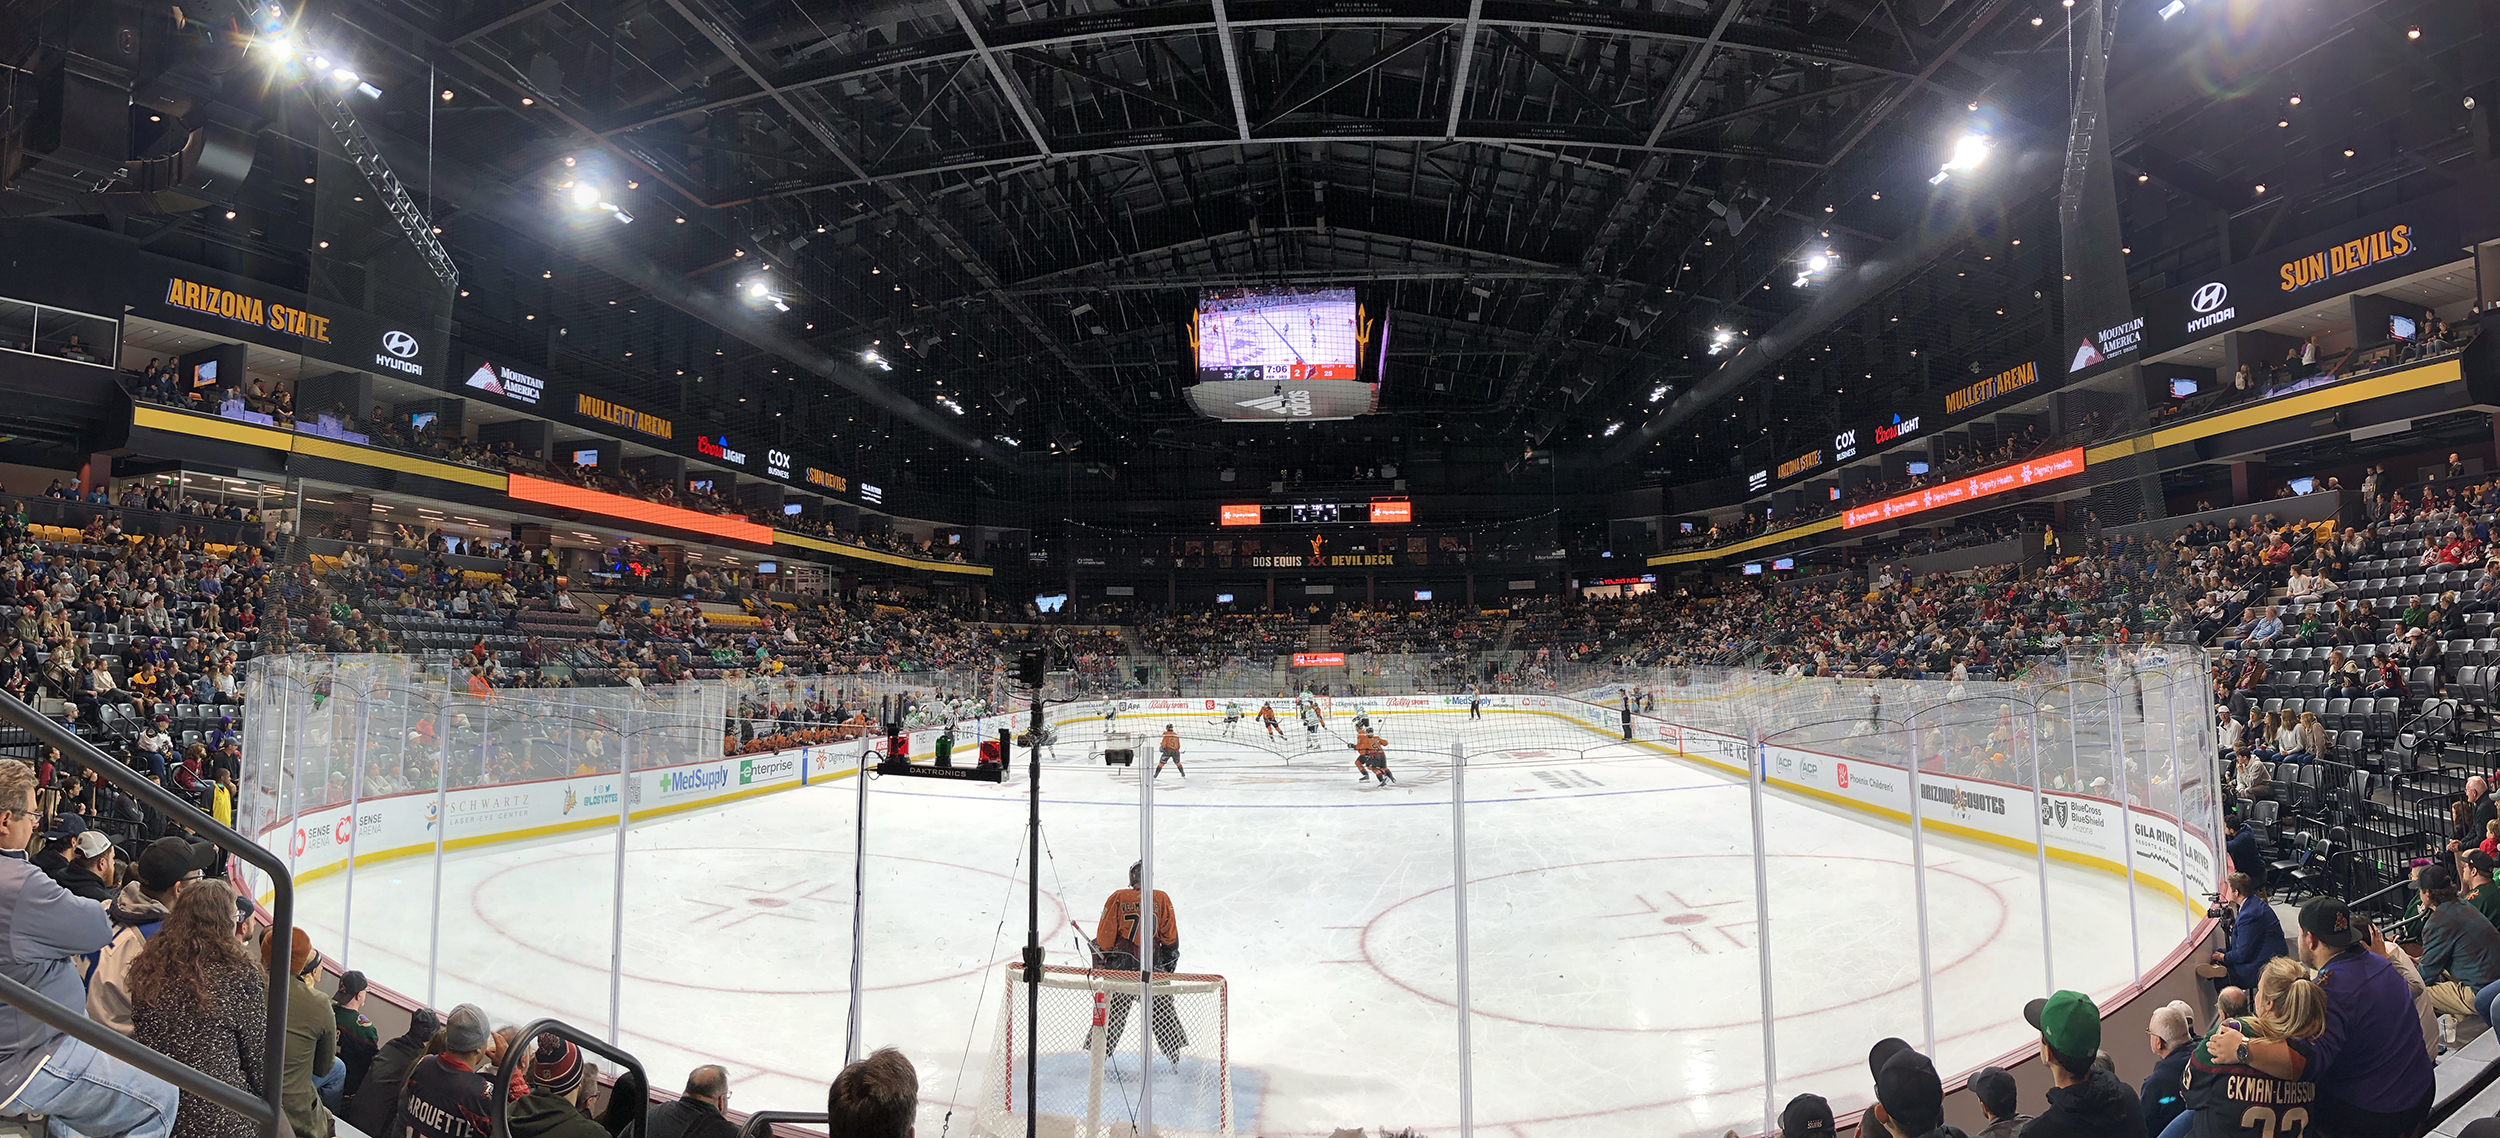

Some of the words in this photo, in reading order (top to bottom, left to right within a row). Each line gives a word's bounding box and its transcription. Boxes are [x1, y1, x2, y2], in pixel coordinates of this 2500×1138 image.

[2280, 251, 2329, 292] SUN
[2329, 224, 2412, 277] DEVILS
[165, 277, 264, 327] ARIZONA
[267, 303, 331, 344] STATE
[2187, 306, 2235, 333] HYUNDAI
[2098, 316, 2144, 344] MOUNTAIN
[2102, 331, 2141, 354] AMERICA
[376, 353, 423, 376] HYUNDAI
[1266, 365, 1287, 374] 7:06
[501, 366, 544, 390] MOUNTAIN
[1253, 370, 1260, 378] 6
[1294, 369, 1301, 377] 2
[503, 379, 541, 400] AMERICA
[1945, 376, 1997, 415] MULLETT
[1996, 360, 2039, 396] ARENA
[575, 393, 635, 429] MULLETT
[633, 411, 673, 440] ARENA
[1875, 425, 1898, 444] Coors
[1897, 416, 1920, 437] LIGHT
[1835, 429, 1856, 450] COX
[698, 435, 723, 459] Coors
[722, 448, 746, 465] LIGHT
[1836, 447, 1856, 462] BUSINESS
[768, 448, 790, 469] COX
[1777, 457, 1801, 480] ARIZONA
[1800, 449, 1822, 471] STATE
[767, 466, 789, 479] BUSINESS
[2034, 465, 2053, 478] Dignity
[2053, 458, 2073, 472] Health
[806, 466, 824, 486] SUN
[824, 471, 847, 493] DEVILS
[1980, 479, 1996, 491] Dignity
[1997, 473, 2014, 486] Health
[1933, 492, 1947, 502] Dignity
[1947, 487, 1963, 498] Health
[1892, 503, 1904, 513] Dignity
[1904, 499, 1918, 508] Health
[1855, 511, 1868, 522] Dignity
[1867, 509, 1879, 518] Health
[1253, 556, 1271, 567] DOS
[1273, 556, 1302, 567] EQUIS
[1331, 555, 1363, 566] DEVIL
[1364, 554, 1394, 566] DECK
[1148, 699, 1171, 711] Bally
[1386, 696, 1410, 707] Bally
[915, 734, 926, 744] THE
[829, 752, 846, 764] Dignity
[1718, 740, 1734, 758] THE
[1736, 744, 1749, 761] KE
[743, 759, 793, 778] enterprise
[1778, 757, 1792, 768] ACP
[1802, 762, 1817, 774] ACP
[672, 765, 728, 791] MedSupply
[909, 766, 967, 778] DAKTRONICS
[1850, 774, 1868, 786] Phoenix
[1869, 778, 1894, 793] Children's
[450, 794, 530, 813] SCHWARTZ
[583, 793, 618, 806] @LOSYOTES
[1961, 793, 2006, 815] COYOTES
[2071, 801, 2102, 816] BlueCross
[359, 813, 382, 826] SENSE
[450, 816, 475, 825] LASER
[478, 813, 494, 822] EYE
[498, 810, 528, 820] CENTER
[2071, 812, 2104, 828] BlueShield
[308, 824, 331, 839] SENSE
[358, 824, 382, 837] ARENA
[2072, 823, 2093, 835] Arizona
[2134, 822, 2155, 840] GILA
[2156, 829, 2178, 849] RIVER
[307, 836, 330, 851] ARENA
[2135, 838, 2157, 850] RESORTS
